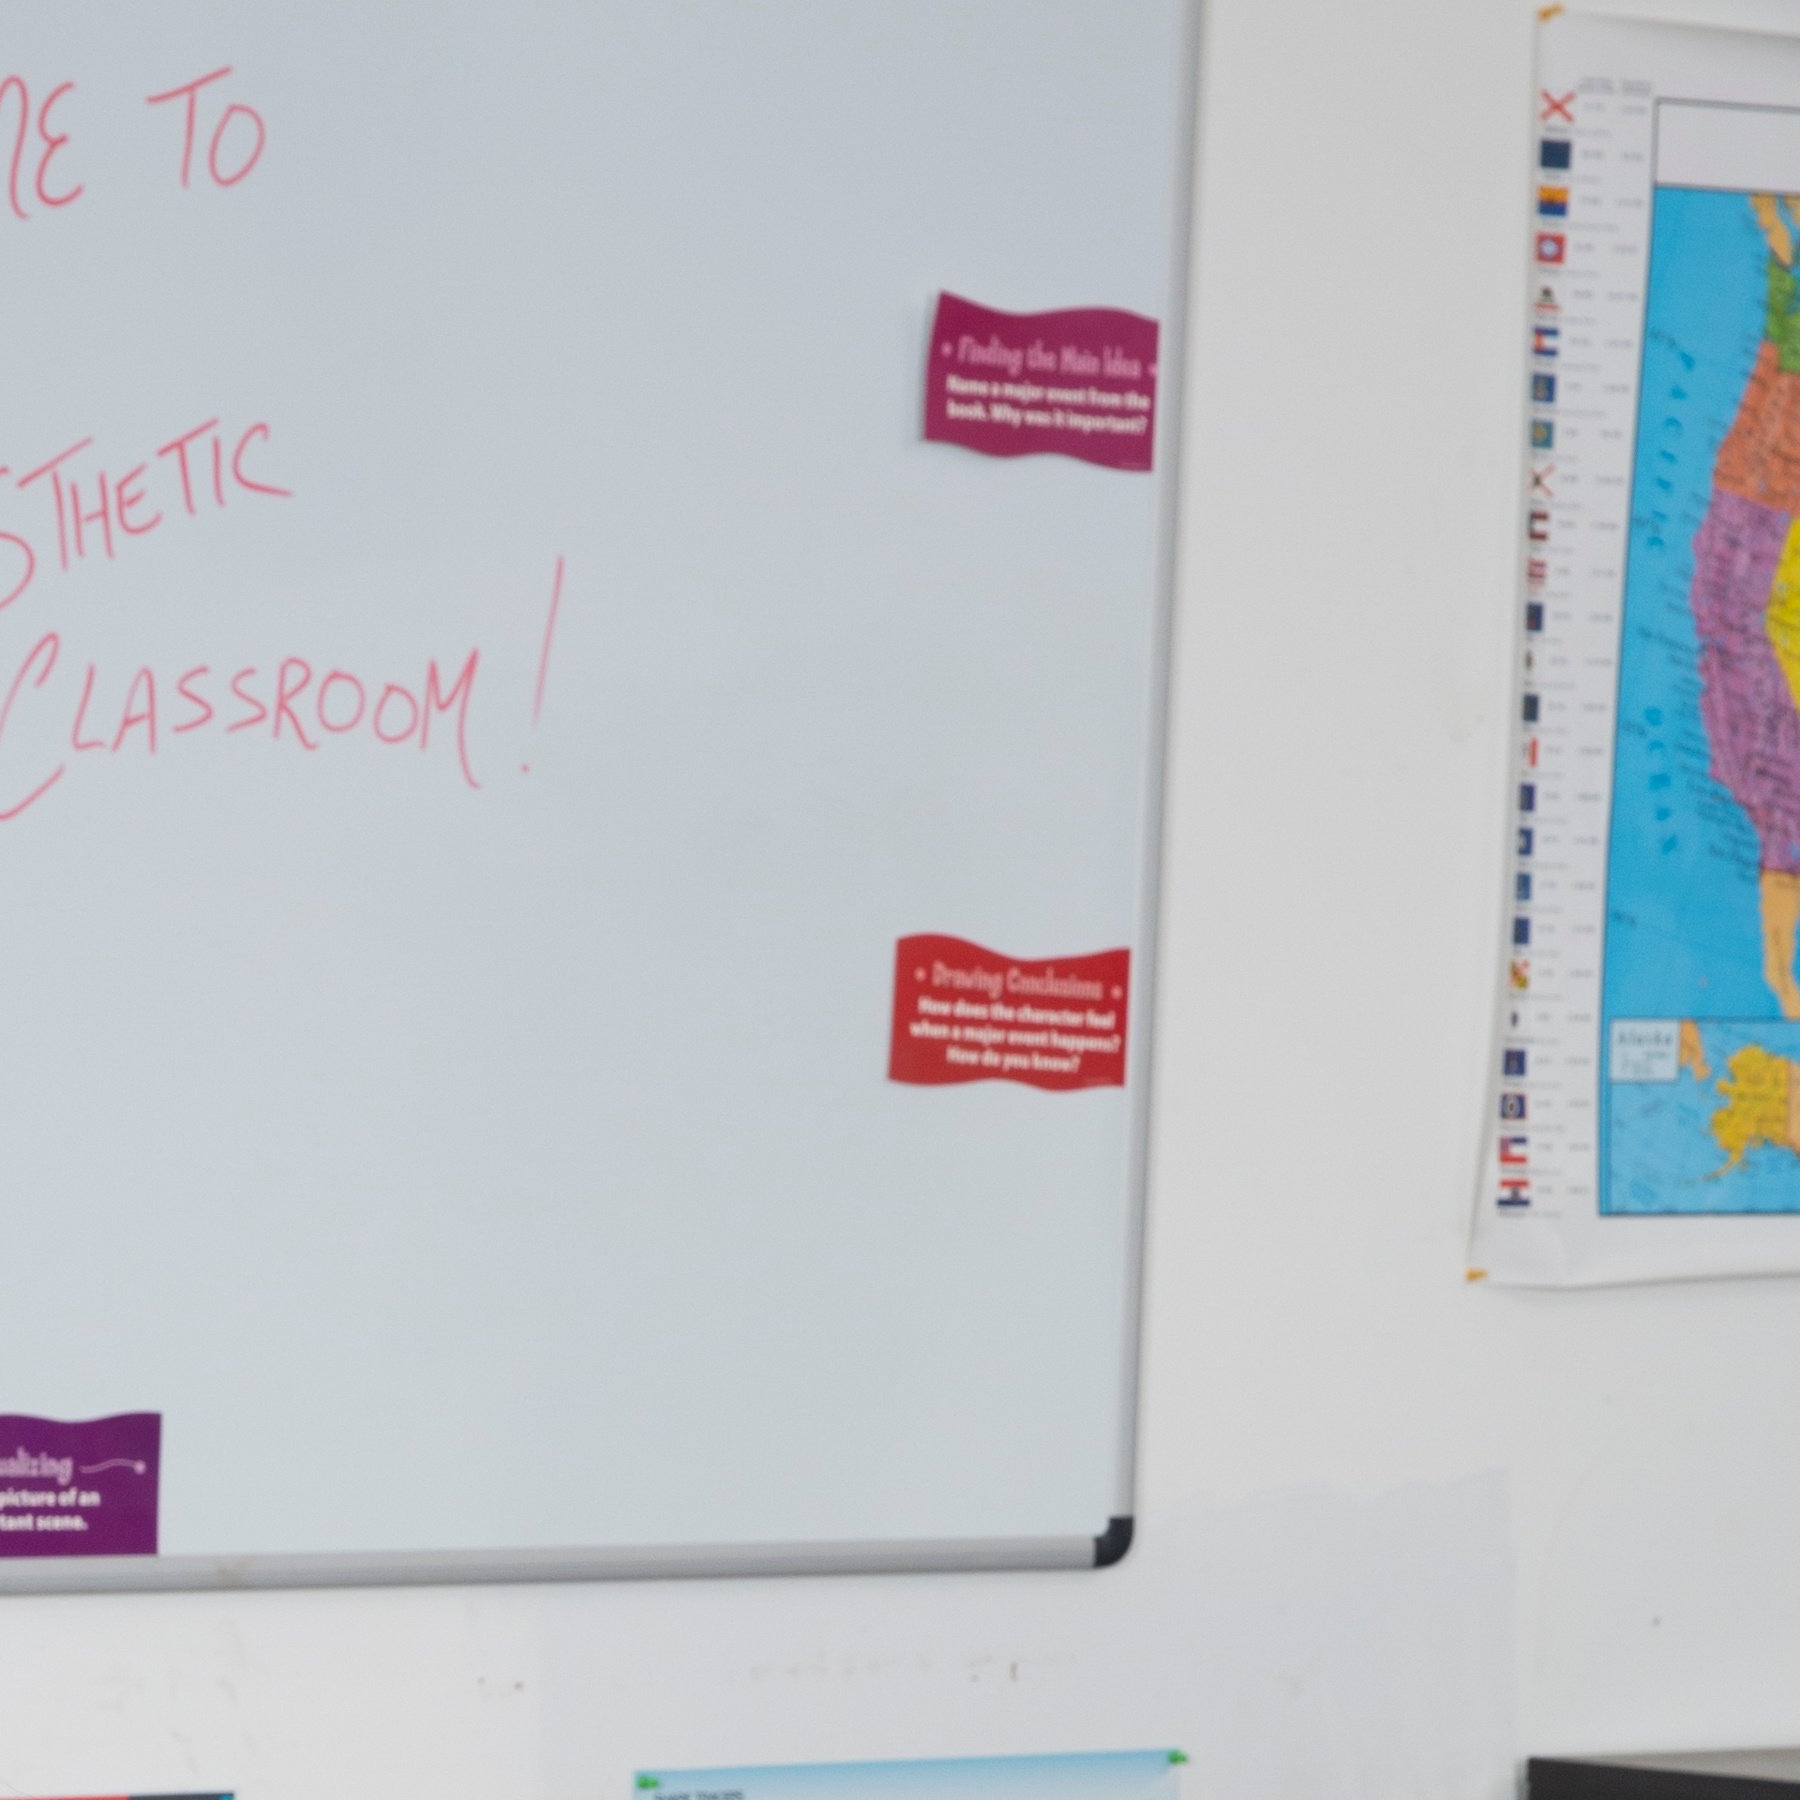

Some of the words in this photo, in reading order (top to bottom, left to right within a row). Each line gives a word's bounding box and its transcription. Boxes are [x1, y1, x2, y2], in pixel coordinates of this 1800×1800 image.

[145, 64, 265, 189] TO
[957, 334, 1024, 377] Finding
[989, 402, 1022, 429] Why
[1066, 408, 1148, 436] important?
[931, 959, 1004, 999] Drawing
[1006, 966, 1103, 1001] Conclusions
[917, 996, 952, 1017] How
[953, 998, 989, 1020] does
[990, 1002, 1015, 1022] the
[1017, 1004, 1084, 1027] character
[909, 1018, 949, 1039] when
[950, 1025, 960, 1040] a
[962, 1024, 1005, 1047] major
[1007, 1029, 1049, 1048] event
[1050, 1029, 1122, 1054] happens?
[946, 1045, 979, 1066] How
[981, 1046, 1000, 1067] do
[1001, 1052, 1030, 1072] you
[1031, 1050, 1081, 1073] know?
[58, 1485, 78, 1508] of
[78, 1490, 101, 1508] an
[36, 1514, 89, 1532] scene.
